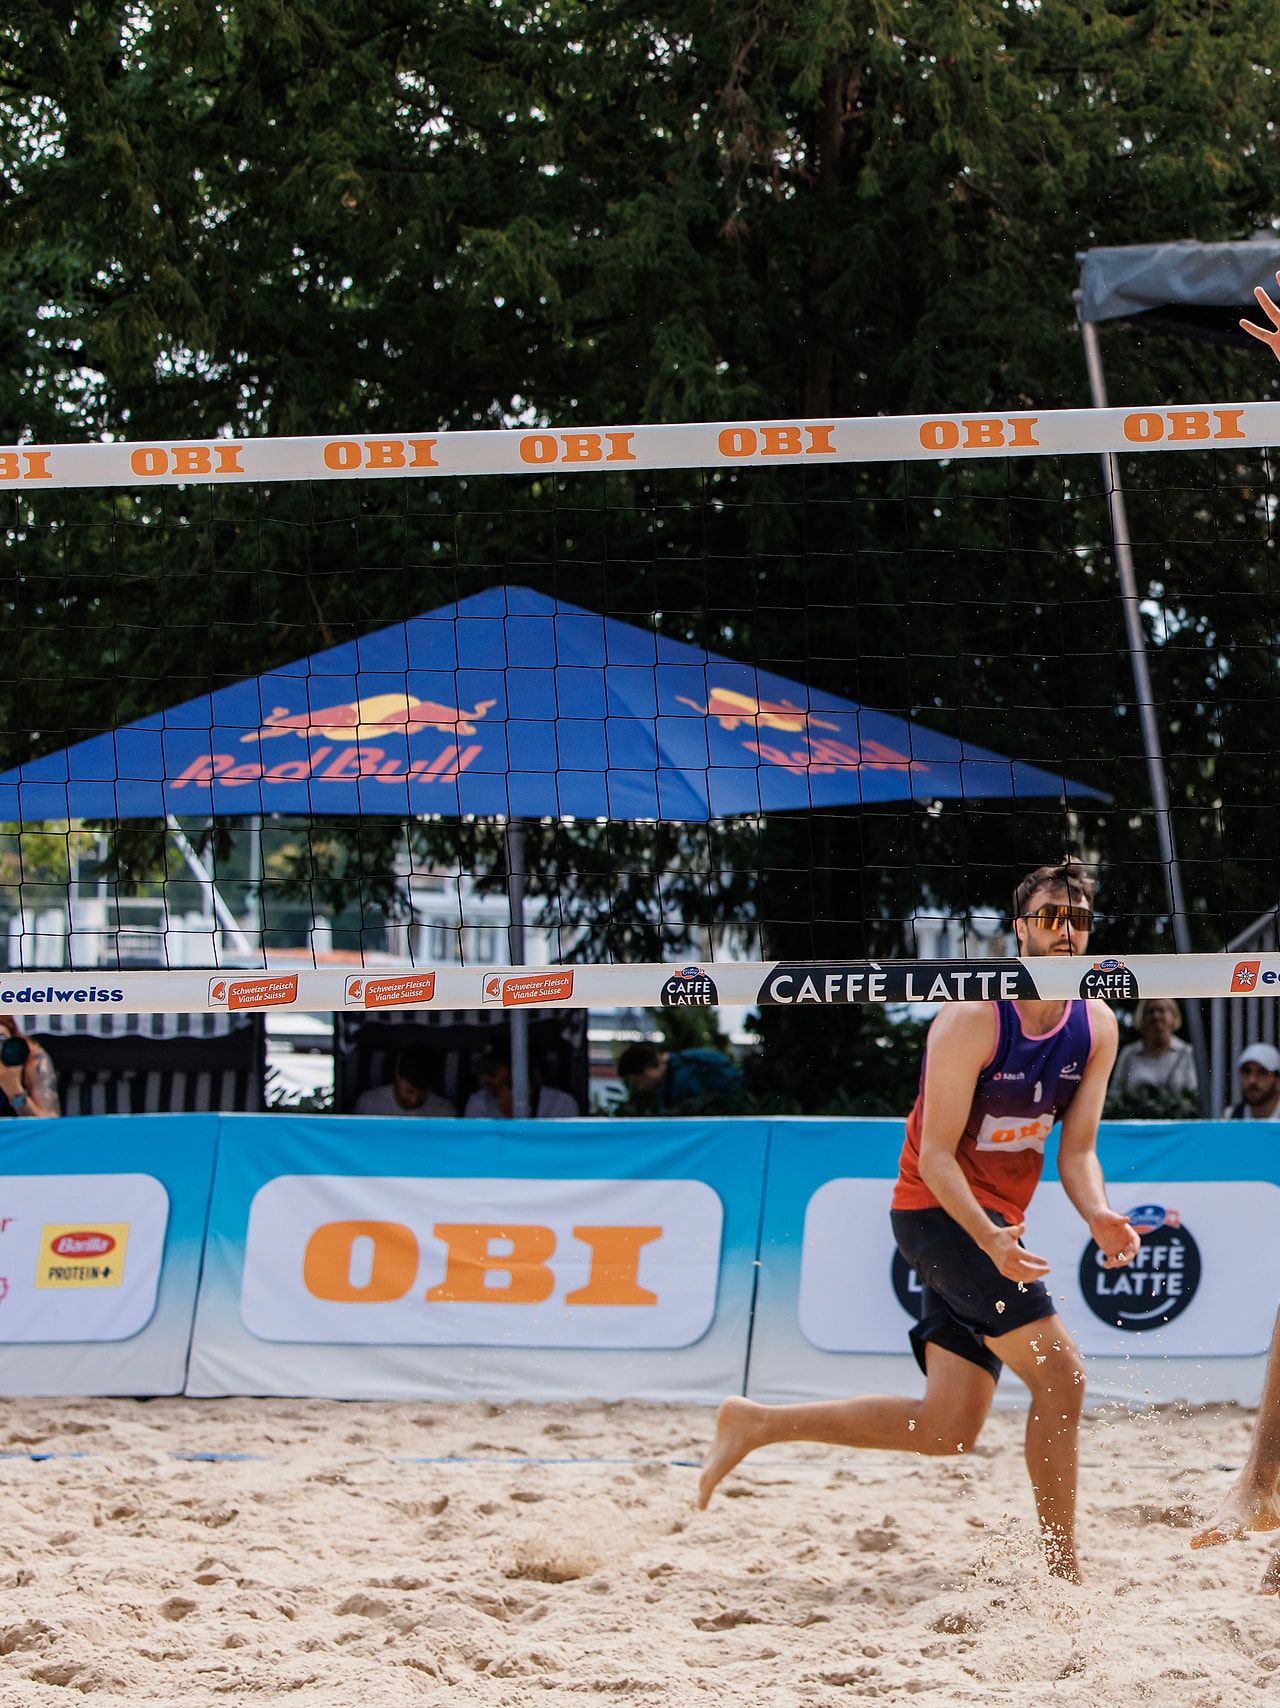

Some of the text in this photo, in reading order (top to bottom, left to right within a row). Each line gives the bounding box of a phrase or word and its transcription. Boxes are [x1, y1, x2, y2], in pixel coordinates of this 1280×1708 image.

[919, 418, 1040, 450] OBI
[1123, 410, 1246, 443] OBI
[519, 432, 636, 464] OBI
[717, 425, 836, 457] OBI
[130, 445, 244, 476] OBI
[323, 439, 439, 470] OBI
[169, 744, 483, 789] Red Bull
[368, 979, 431, 994] Schweizer Fleisch
[506, 977, 569, 992] Schweizer Fleisch
[667, 977, 711, 994] CAFFÈ
[769, 963, 1019, 1003] CAFFÈ LATTE
[1085, 970, 1131, 987] CAFFÈ
[0, 987, 125, 1005] edelweiss
[232, 981, 294, 996] Schweizer Fleisch
[239, 991, 287, 1003] Viande Suisse
[375, 989, 424, 1001] Viande Suisse
[513, 988, 562, 999] Viande Suisse
[1087, 987, 1132, 999] LATTE
[668, 994, 712, 1006] LATTE
[302, 1220, 663, 1306] OBI
[1096, 1272, 1184, 1296] LATTE
